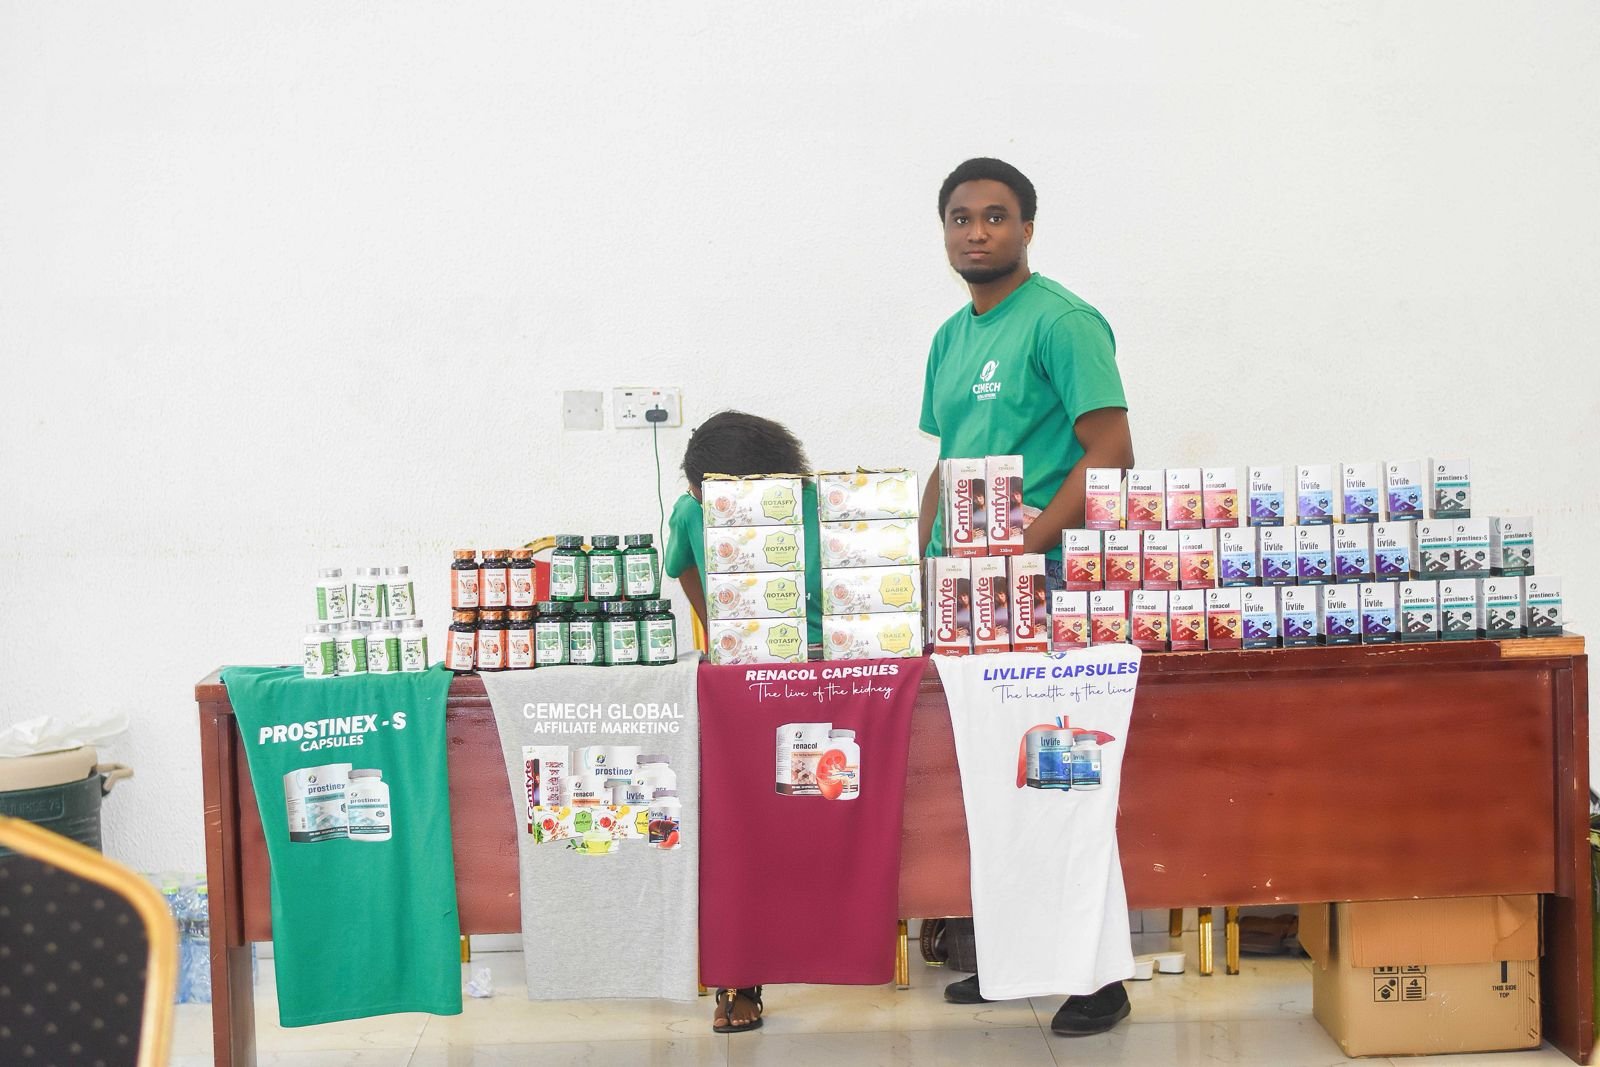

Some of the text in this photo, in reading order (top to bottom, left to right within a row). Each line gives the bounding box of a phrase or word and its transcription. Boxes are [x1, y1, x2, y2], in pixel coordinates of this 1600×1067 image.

[954, 479, 972, 543] C-mfyte
[990, 476, 1009, 541] C-mfyte
[937, 578, 956, 642] C-mfyte
[976, 577, 995, 641] C-mfyte
[1015, 574, 1034, 639] C-mfyte
[745, 664, 899, 681] RENACOL CAPSULES
[983, 661, 1138, 681] LIVLIFE CAPSULES
[749, 680, 894, 703] The live of the kidney
[992, 681, 1135, 704] The health of the liver
[523, 702, 684, 720] CEMECH GLOBAL
[258, 713, 378, 745] PROSTINEX
[533, 721, 680, 734] AFFILIATE MARKETING
[300, 734, 364, 752] CAPSULES
[792, 742, 818, 750] renacol
[1040, 736, 1061, 747] livlife
[595, 766, 633, 777] prostinex
[307, 782, 346, 795] prostinex
[626, 790, 645, 800] livlife
[1409, 979, 1418, 987] 4
